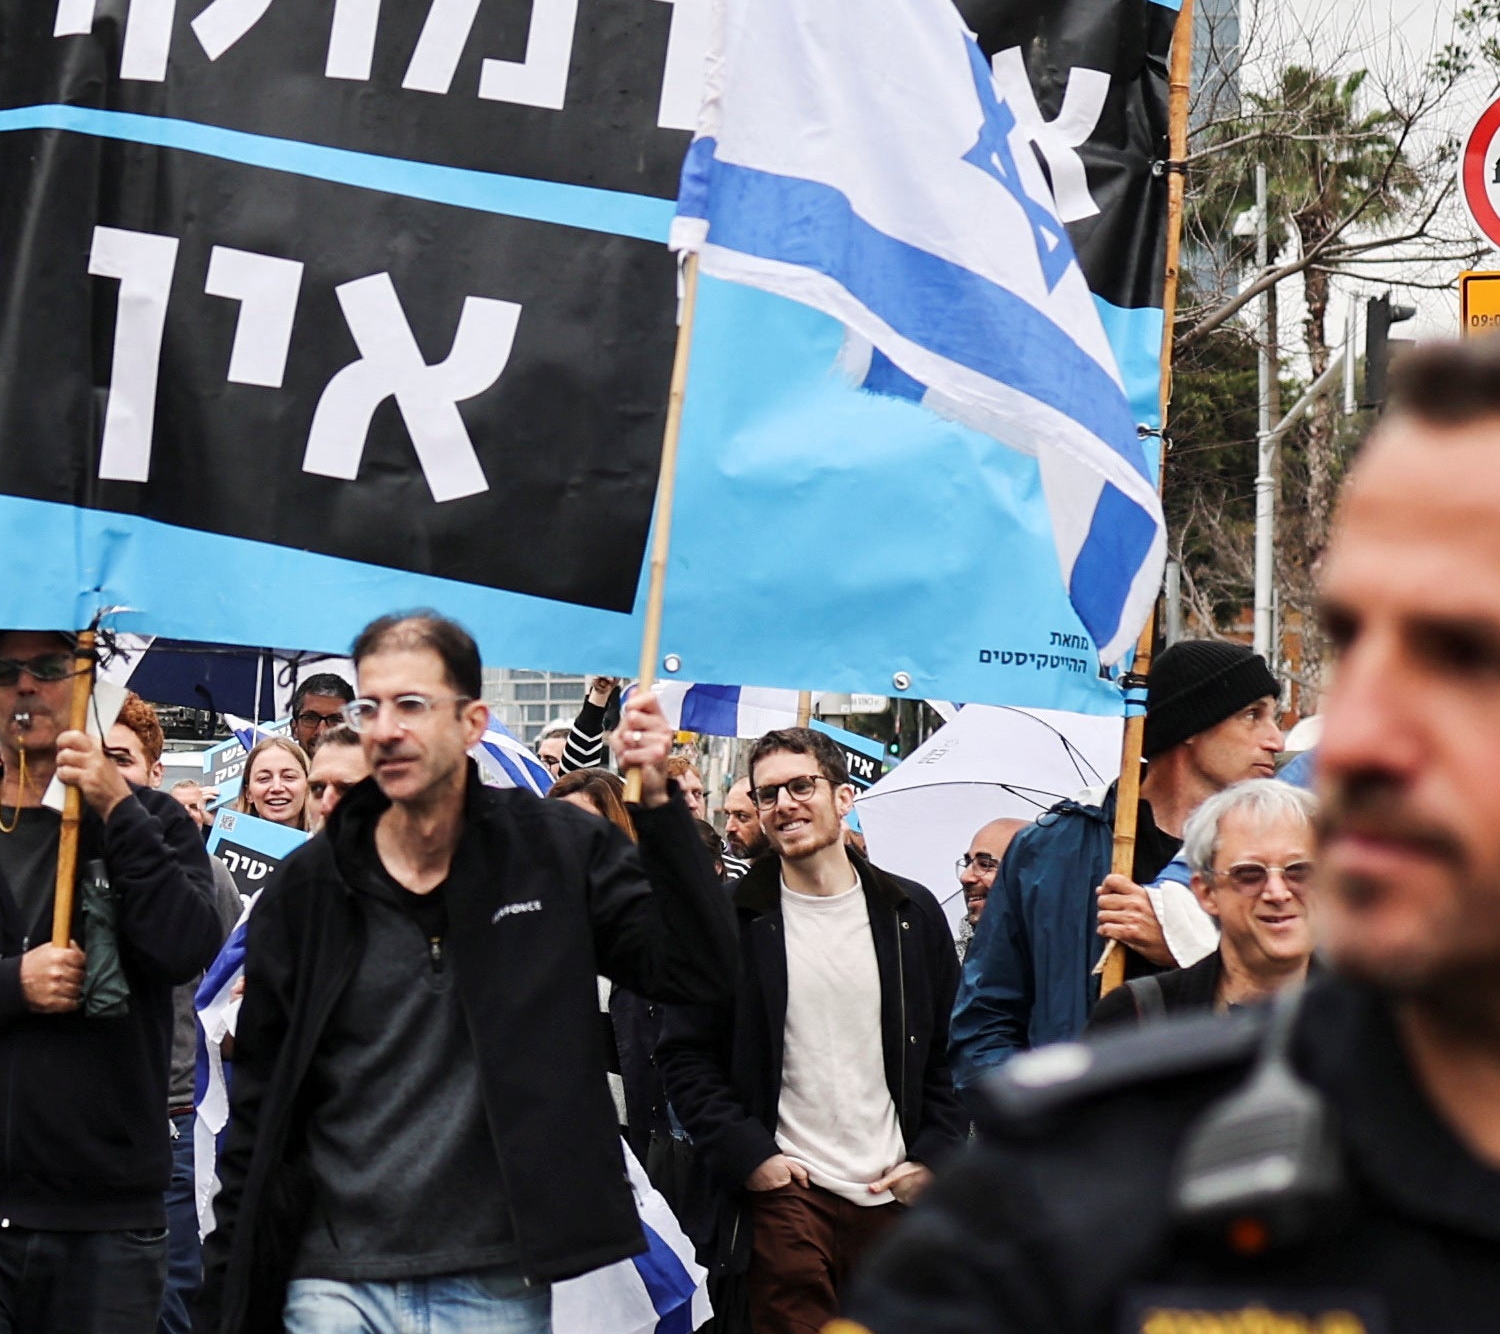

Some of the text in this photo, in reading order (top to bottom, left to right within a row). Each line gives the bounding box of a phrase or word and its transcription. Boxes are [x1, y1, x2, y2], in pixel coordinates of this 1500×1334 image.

[85, 224, 523, 504] אין
[1049, 631, 1089, 651] מחאת
[979, 649, 1088, 674] ההייטקיסטים
